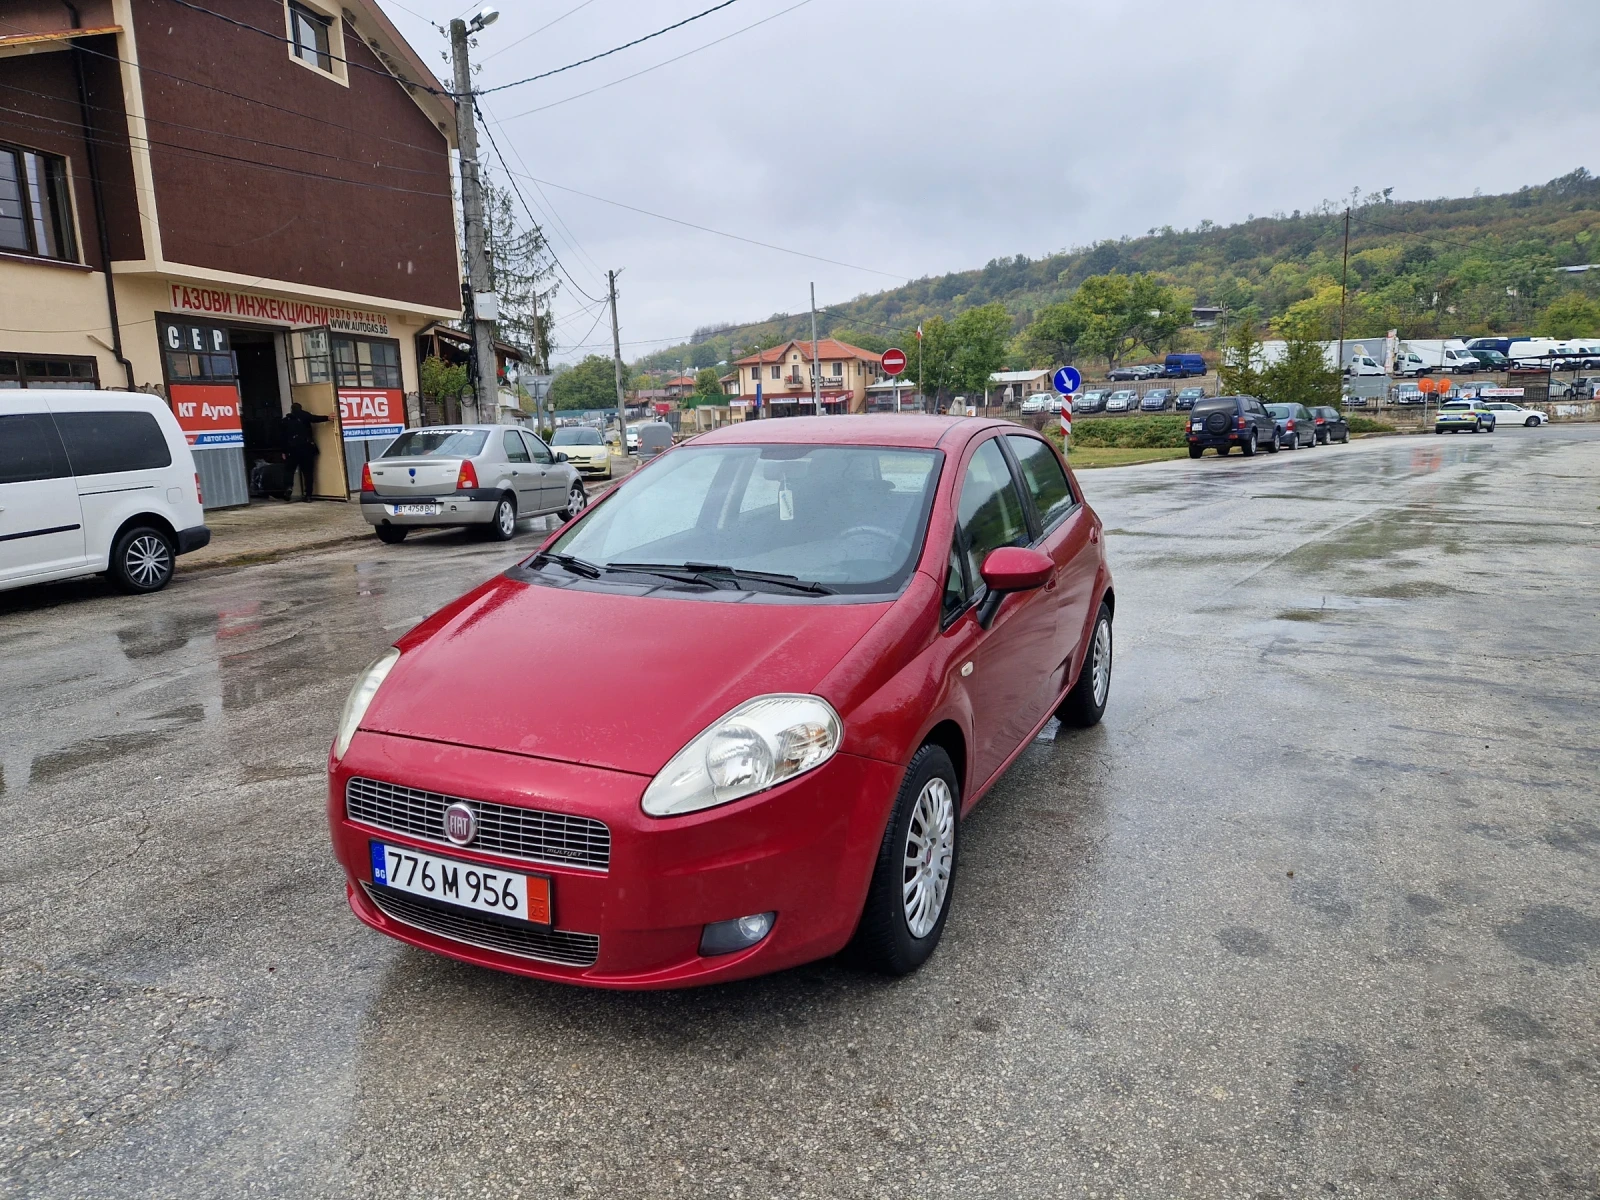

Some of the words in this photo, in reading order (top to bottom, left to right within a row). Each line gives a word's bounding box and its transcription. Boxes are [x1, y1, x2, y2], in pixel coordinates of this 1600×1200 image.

[171, 284, 232, 314] ГАЗОВИ
[234, 293, 329, 326] ИНЖЕКЦИОНИ
[330, 308, 351, 321] 0876
[353, 311, 363, 321] 99
[366, 313, 375, 323] 44
[377, 314, 387, 325] 06
[330, 318, 388, 334] WWW.AUTOGAS.BG
[177, 402, 197, 417] КГ
[201, 402, 233, 420] Ауто
[339, 396, 389, 418] STAG
[449, 815, 469, 836] FIAT
[374, 867, 386, 879] BG
[387, 851, 436, 892] 776
[441, 864, 460, 899] M
[465, 870, 519, 911] 956
[531, 904, 545, 918] 25
